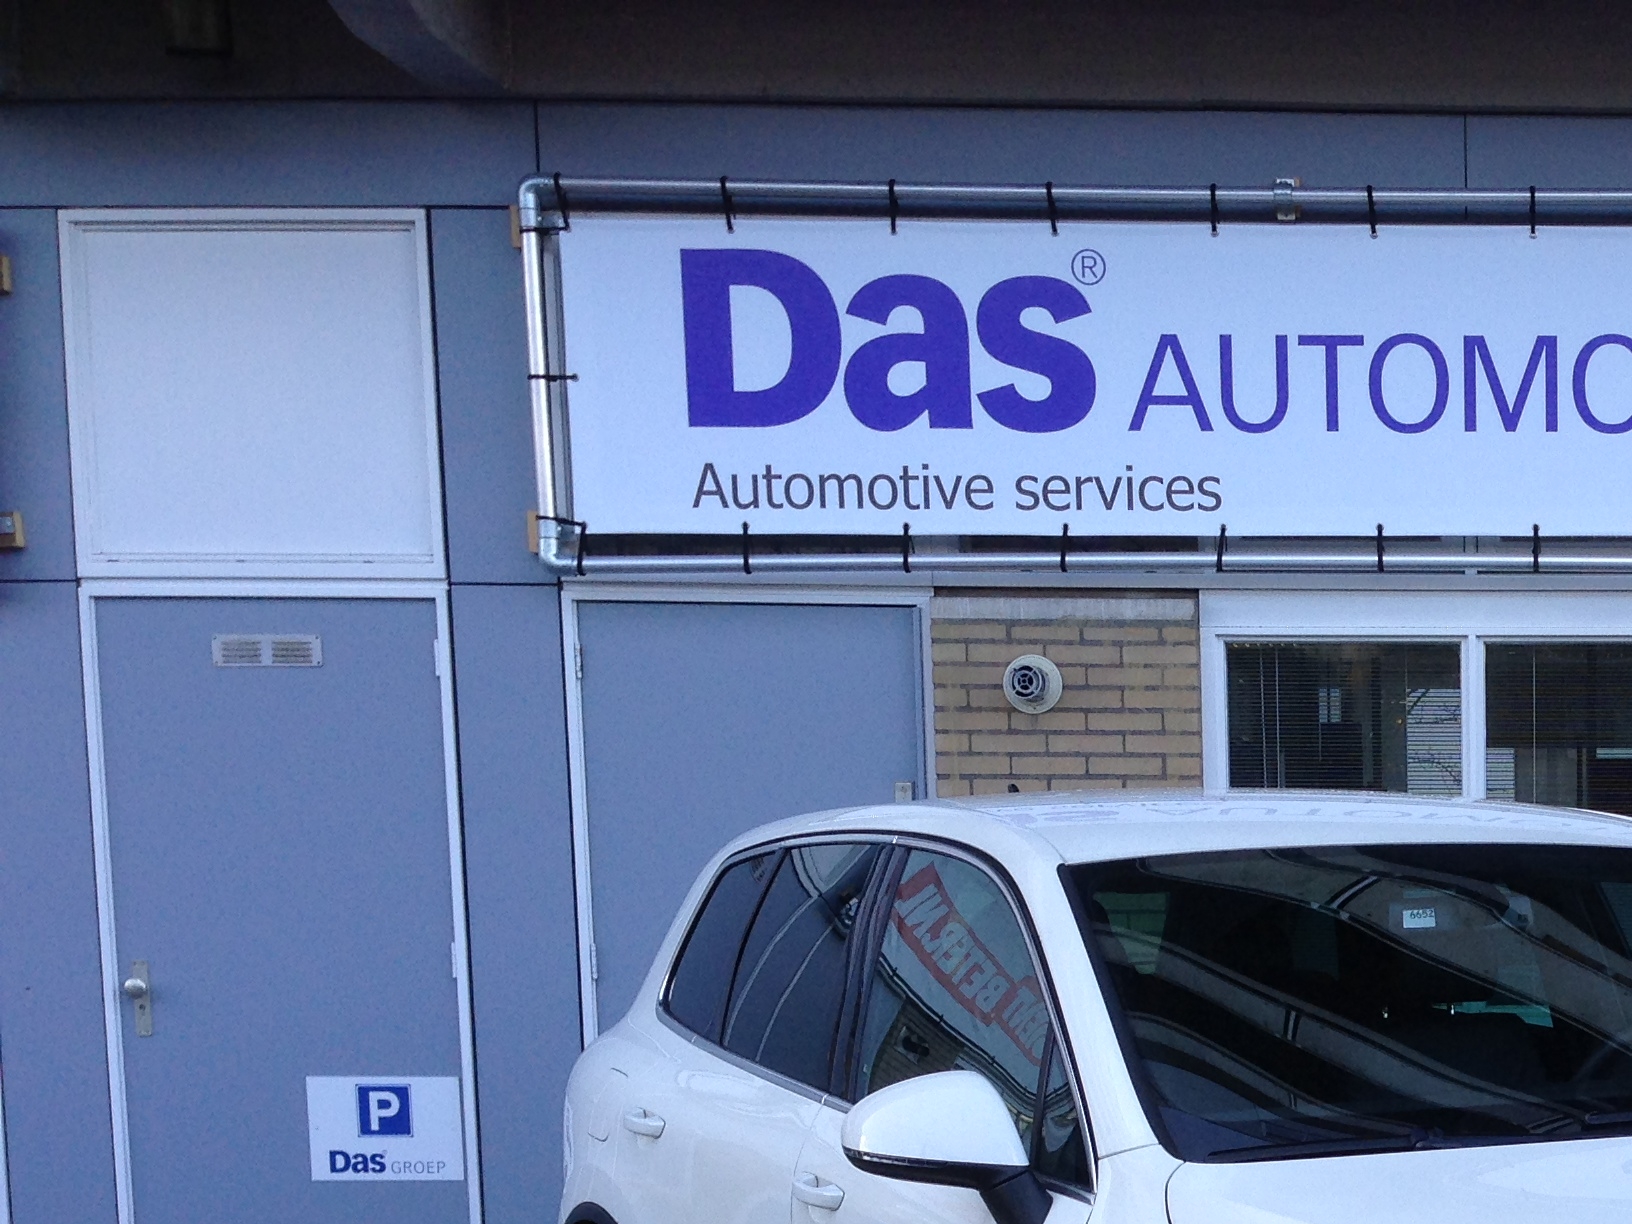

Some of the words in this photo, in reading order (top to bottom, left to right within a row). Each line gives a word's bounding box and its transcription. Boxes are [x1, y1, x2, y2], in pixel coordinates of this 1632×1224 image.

[692, 462, 995, 511] Automotive
[1014, 464, 1223, 512] services
[368, 1090, 400, 1132] P
[329, 1149, 387, 1174] Das
[391, 1161, 446, 1174] GROEP
